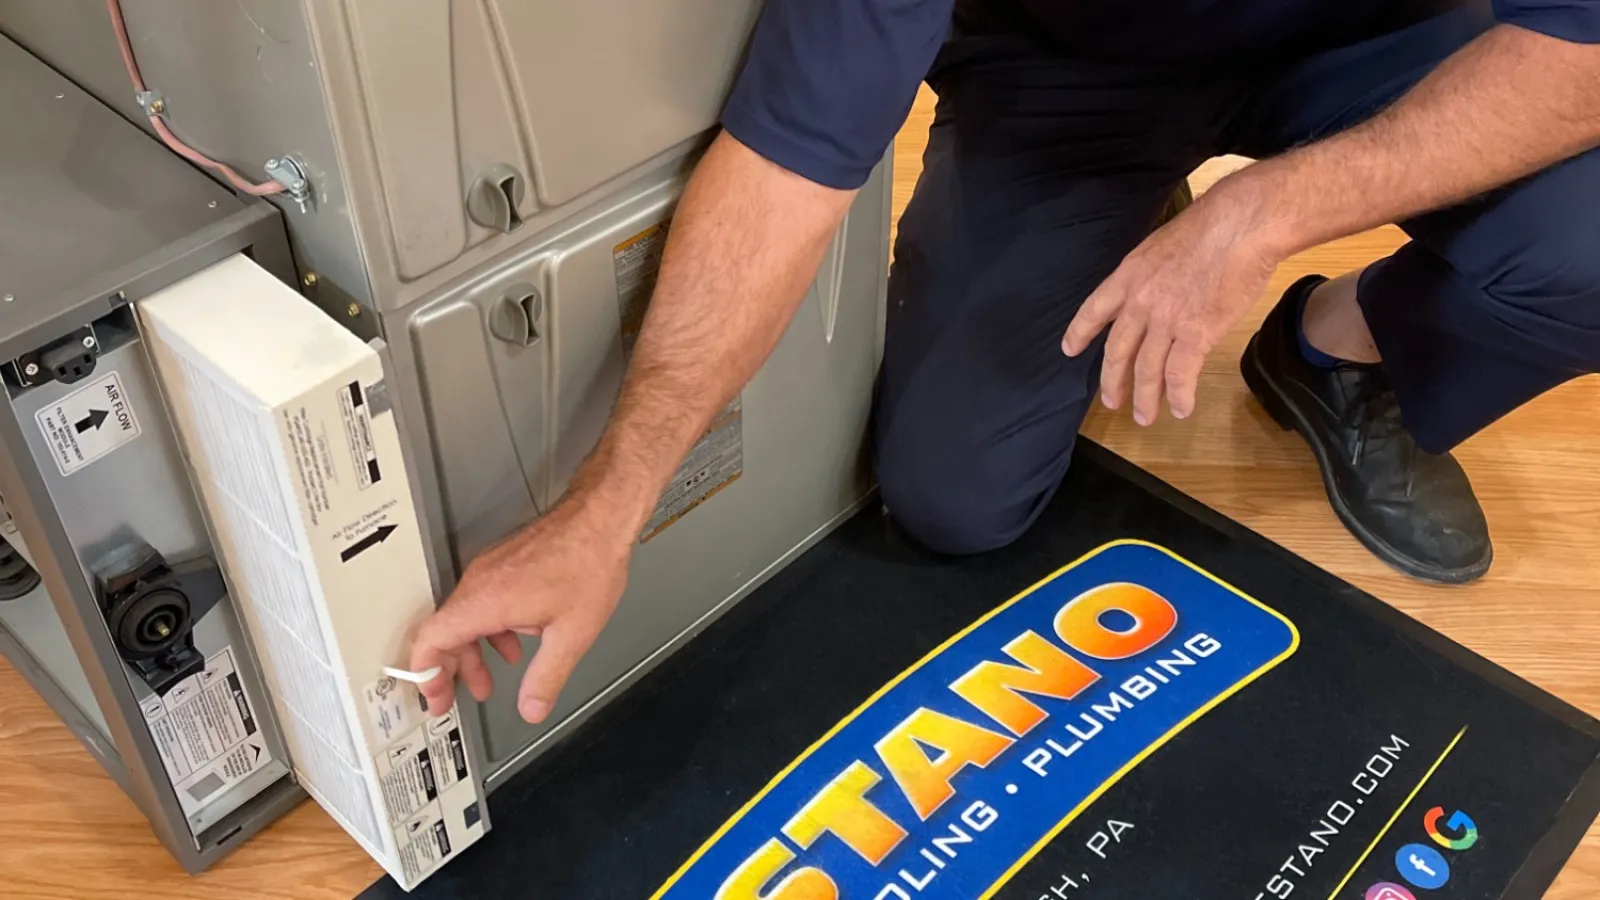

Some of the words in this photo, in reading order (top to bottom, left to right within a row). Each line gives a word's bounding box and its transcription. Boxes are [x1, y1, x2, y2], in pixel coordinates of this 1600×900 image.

[104, 384, 119, 403] AIR
[113, 402, 132, 431] FLOW
[1021, 632, 1222, 778] PLUMBING
[1086, 819, 1135, 859] PA
